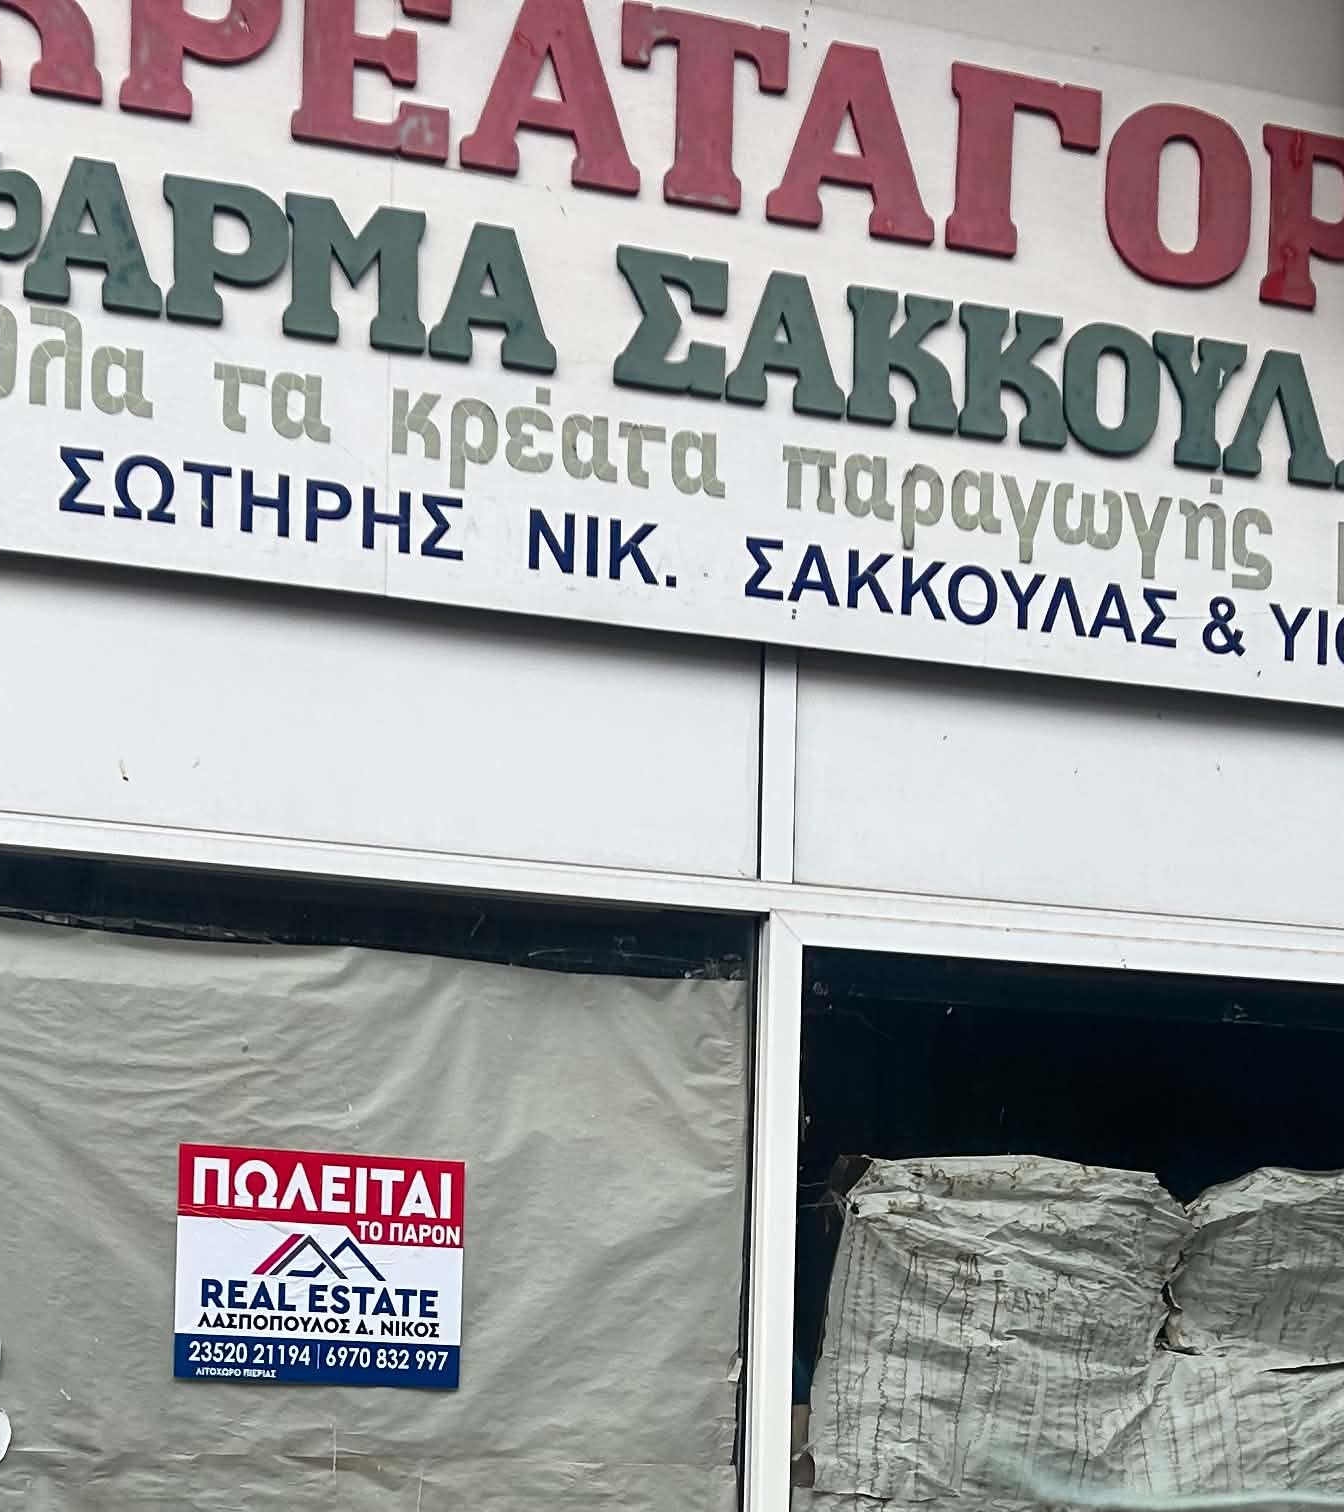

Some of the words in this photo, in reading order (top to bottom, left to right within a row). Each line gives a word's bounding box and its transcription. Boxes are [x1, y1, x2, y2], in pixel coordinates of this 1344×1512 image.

[214, 361, 331, 443] τα
[391, 387, 726, 499] κρέατα
[782, 443, 1273, 592] παραγωγής
[58, 447, 463, 561] ΣΩΤΗΡΗΣ
[528, 509, 678, 588] ΝΙΚ.
[745, 537, 1177, 648] ΣΑΚΚΟΥΛΑΣ
[1202, 597, 1245, 657] &
[192, 1156, 452, 1219] ΠΩΛΕΙΤΑΙ
[357, 1220, 383, 1241] ΤΟ
[389, 1223, 460, 1246] ΠΑΡΟΝ
[201, 1278, 297, 1312] REAL
[308, 1282, 439, 1319] ESTATE
[197, 1312, 351, 1335] ΛΑΣΠΟΠΟΥΛΟΣ
[355, 1319, 374, 1336] Δ.
[380, 1321, 440, 1338] ΝΙΚΟΣ
[188, 1340, 248, 1363] 23520
[252, 1343, 311, 1366] 21194
[325, 1347, 371, 1369] 6970
[375, 1349, 410, 1370] 832
[414, 1350, 449, 1371] 997
